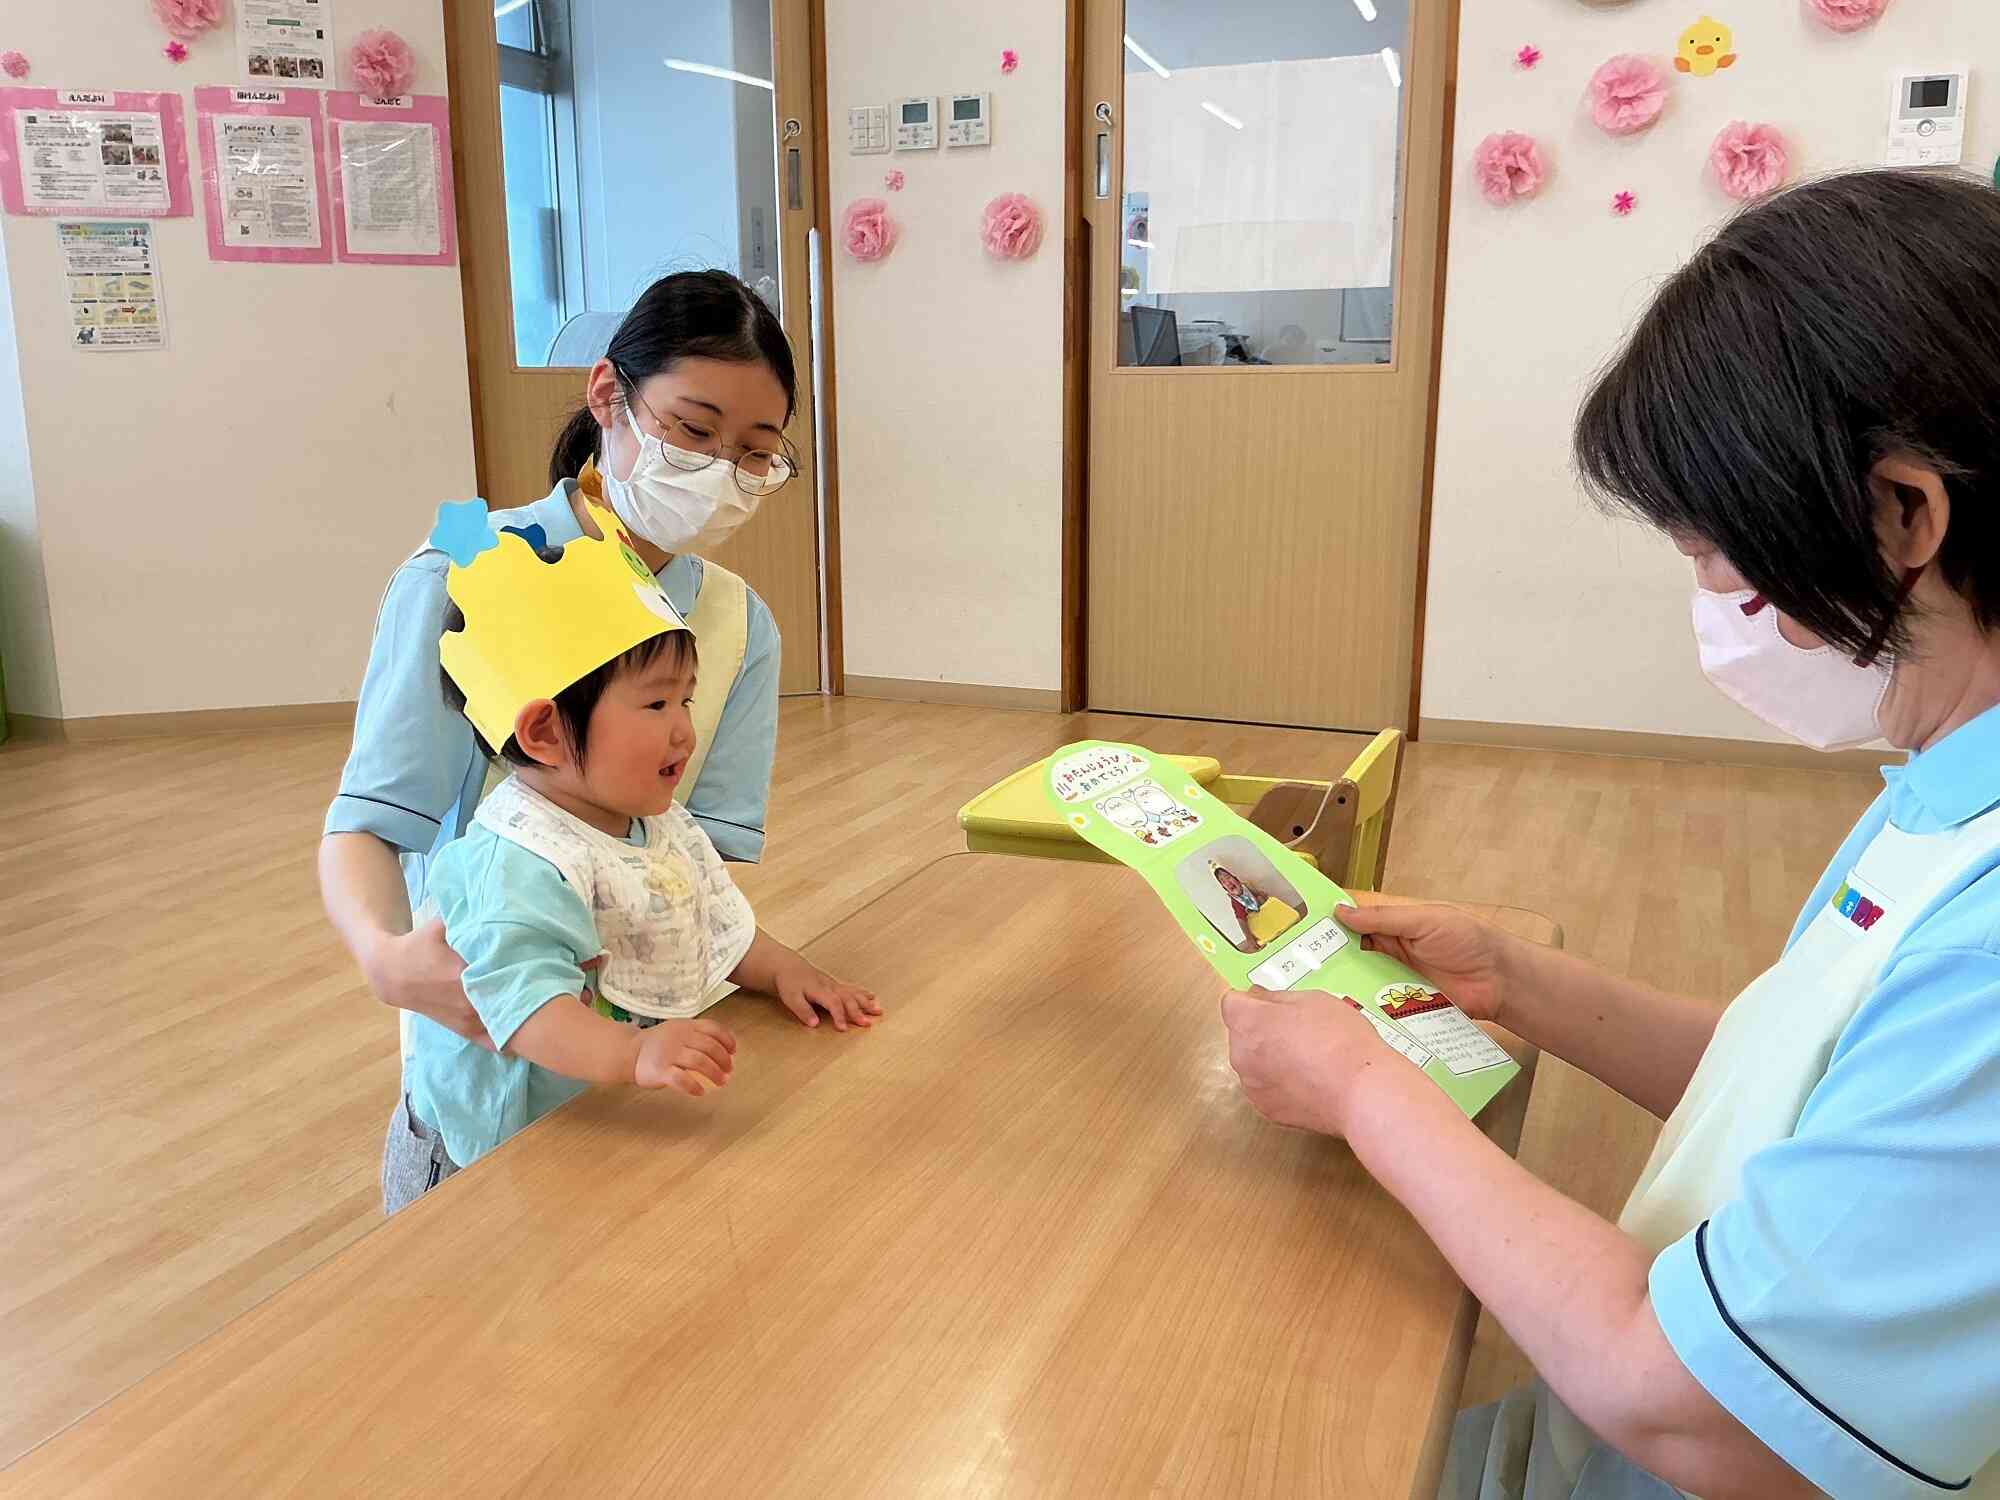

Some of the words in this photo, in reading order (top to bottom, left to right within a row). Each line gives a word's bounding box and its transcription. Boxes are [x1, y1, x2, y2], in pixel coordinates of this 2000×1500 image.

[1062, 755, 1119, 783] おたんじょうび
